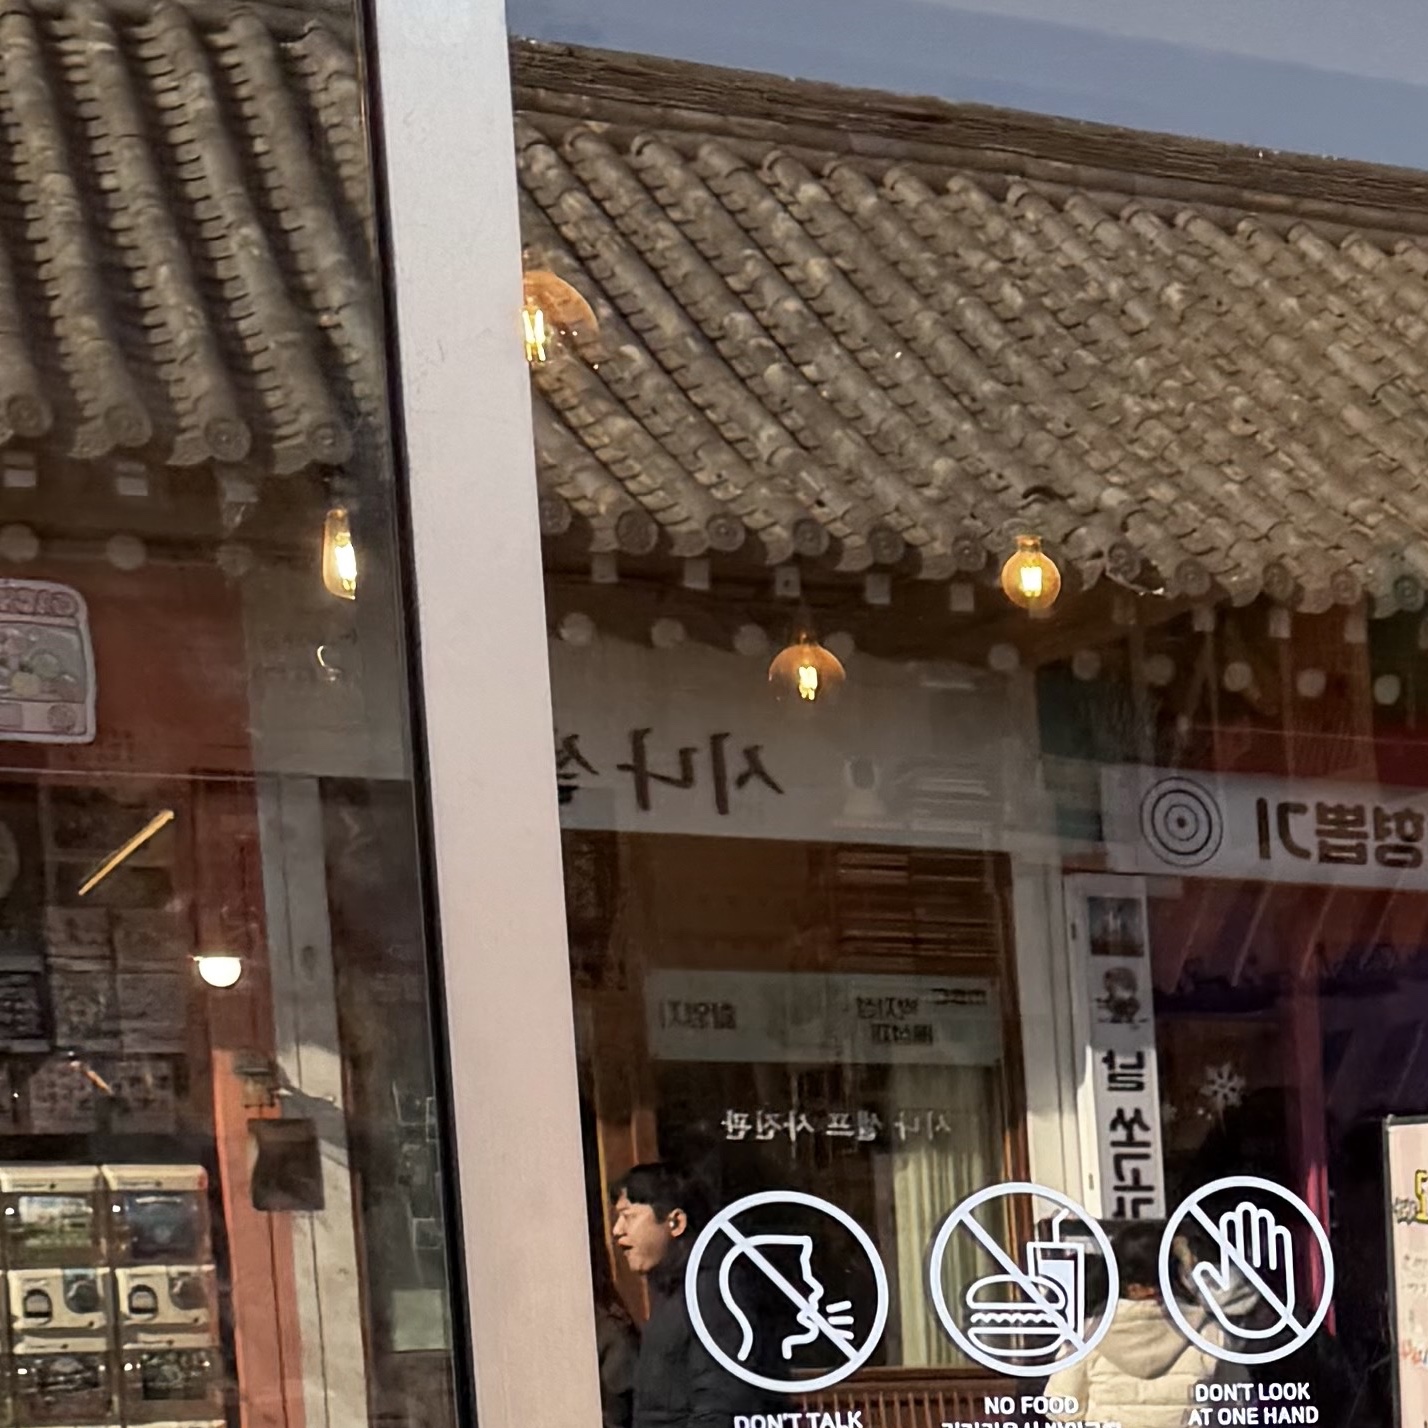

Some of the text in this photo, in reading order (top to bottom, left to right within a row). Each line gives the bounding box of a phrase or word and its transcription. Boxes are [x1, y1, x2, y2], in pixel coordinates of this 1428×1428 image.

[1194, 1382, 1312, 1403] DON'T LOOK
[984, 1395, 1080, 1416] NO FOOD
[1188, 1405, 1320, 1427] AT ONE HAND
